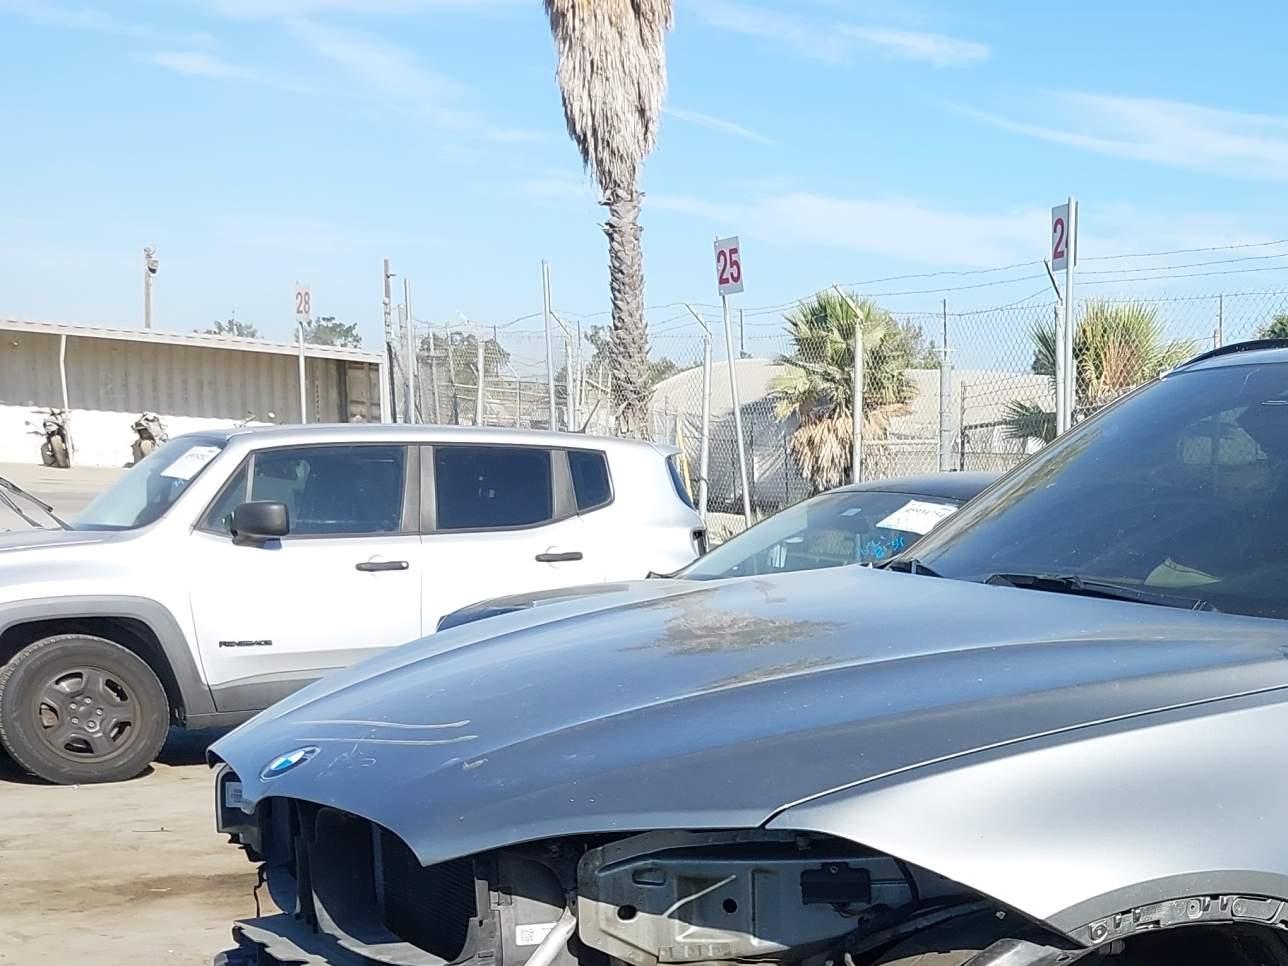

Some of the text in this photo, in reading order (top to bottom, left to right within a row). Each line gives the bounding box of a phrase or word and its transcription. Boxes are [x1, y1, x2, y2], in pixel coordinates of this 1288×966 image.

[1053, 217, 1068, 259] 2
[717, 247, 740, 285] 25
[296, 291, 311, 314] 28
